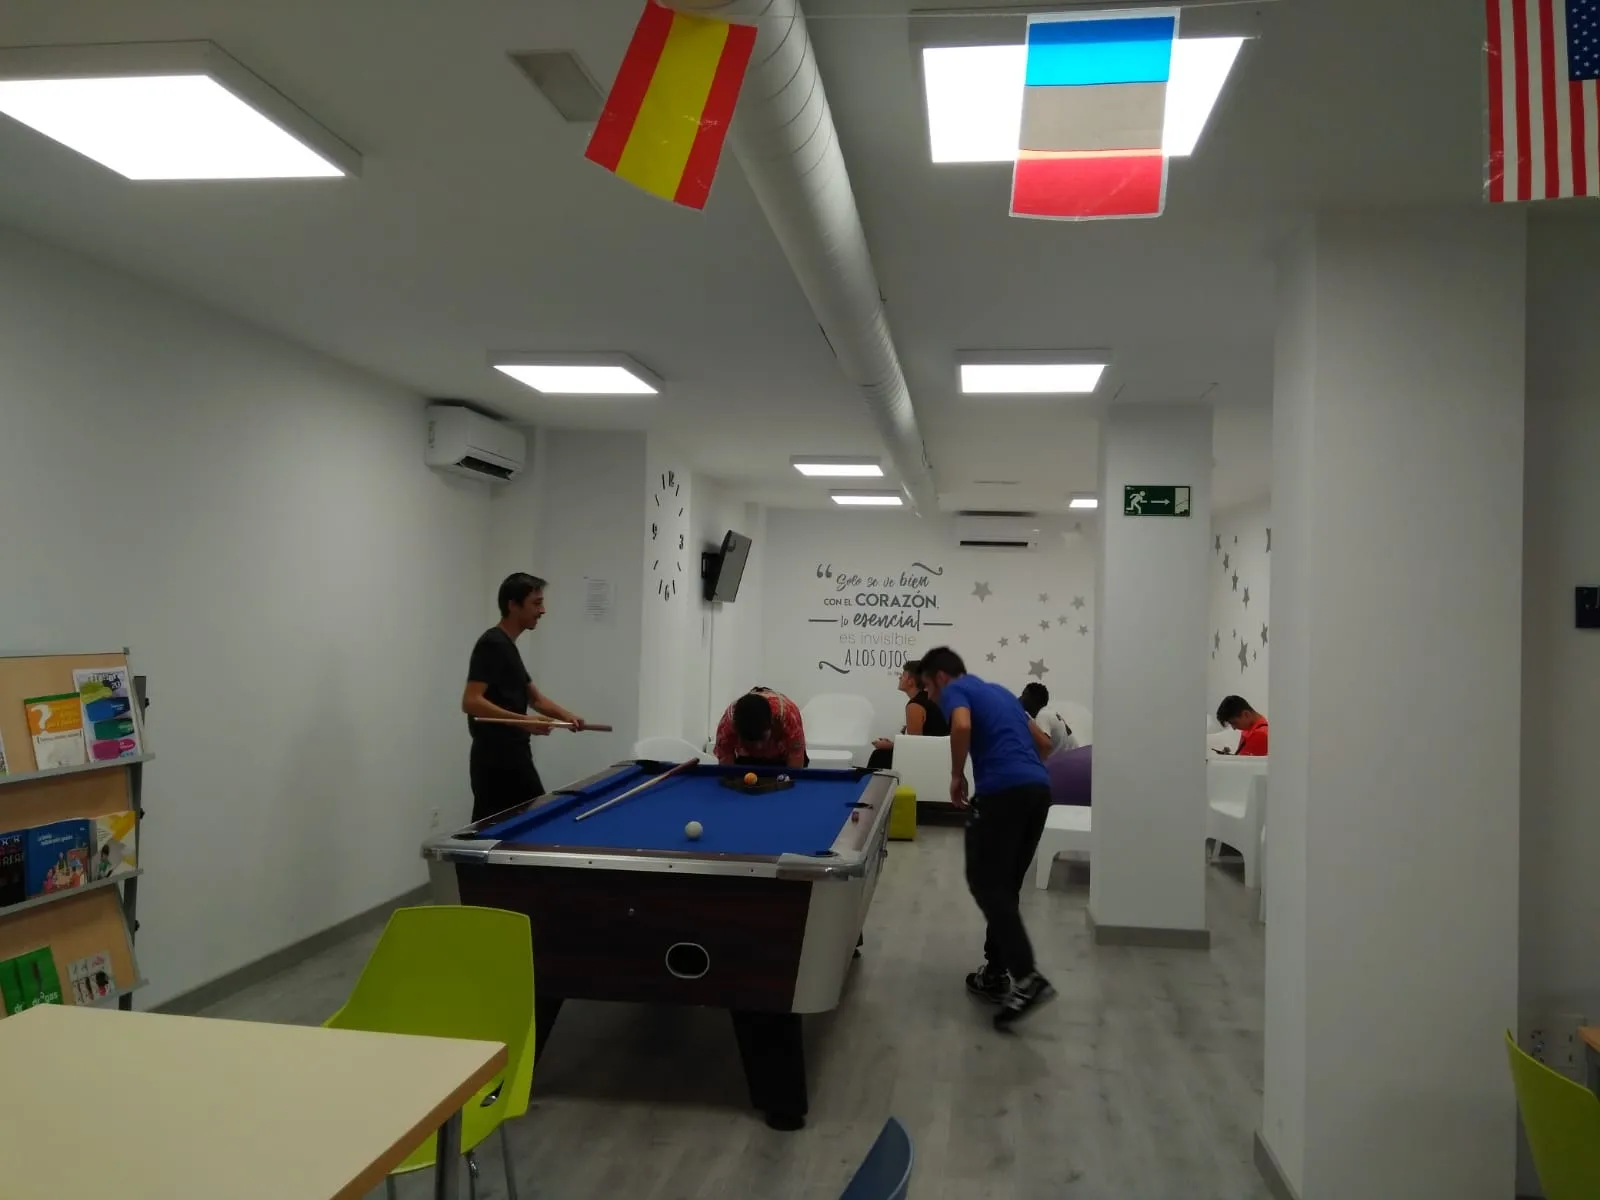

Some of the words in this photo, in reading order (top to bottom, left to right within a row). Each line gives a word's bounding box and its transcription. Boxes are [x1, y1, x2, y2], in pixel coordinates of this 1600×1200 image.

[899, 571, 929, 589] bien
[823, 598, 842, 606] CON
[843, 598, 853, 606] EL
[840, 615, 849, 628] lo
[853, 609, 921, 632] esencial
[839, 633, 856, 645] es
[860, 632, 917, 646] invisible
[845, 649, 852, 667] A
[856, 649, 876, 667] LOS
[879, 649, 908, 669] OJOS
